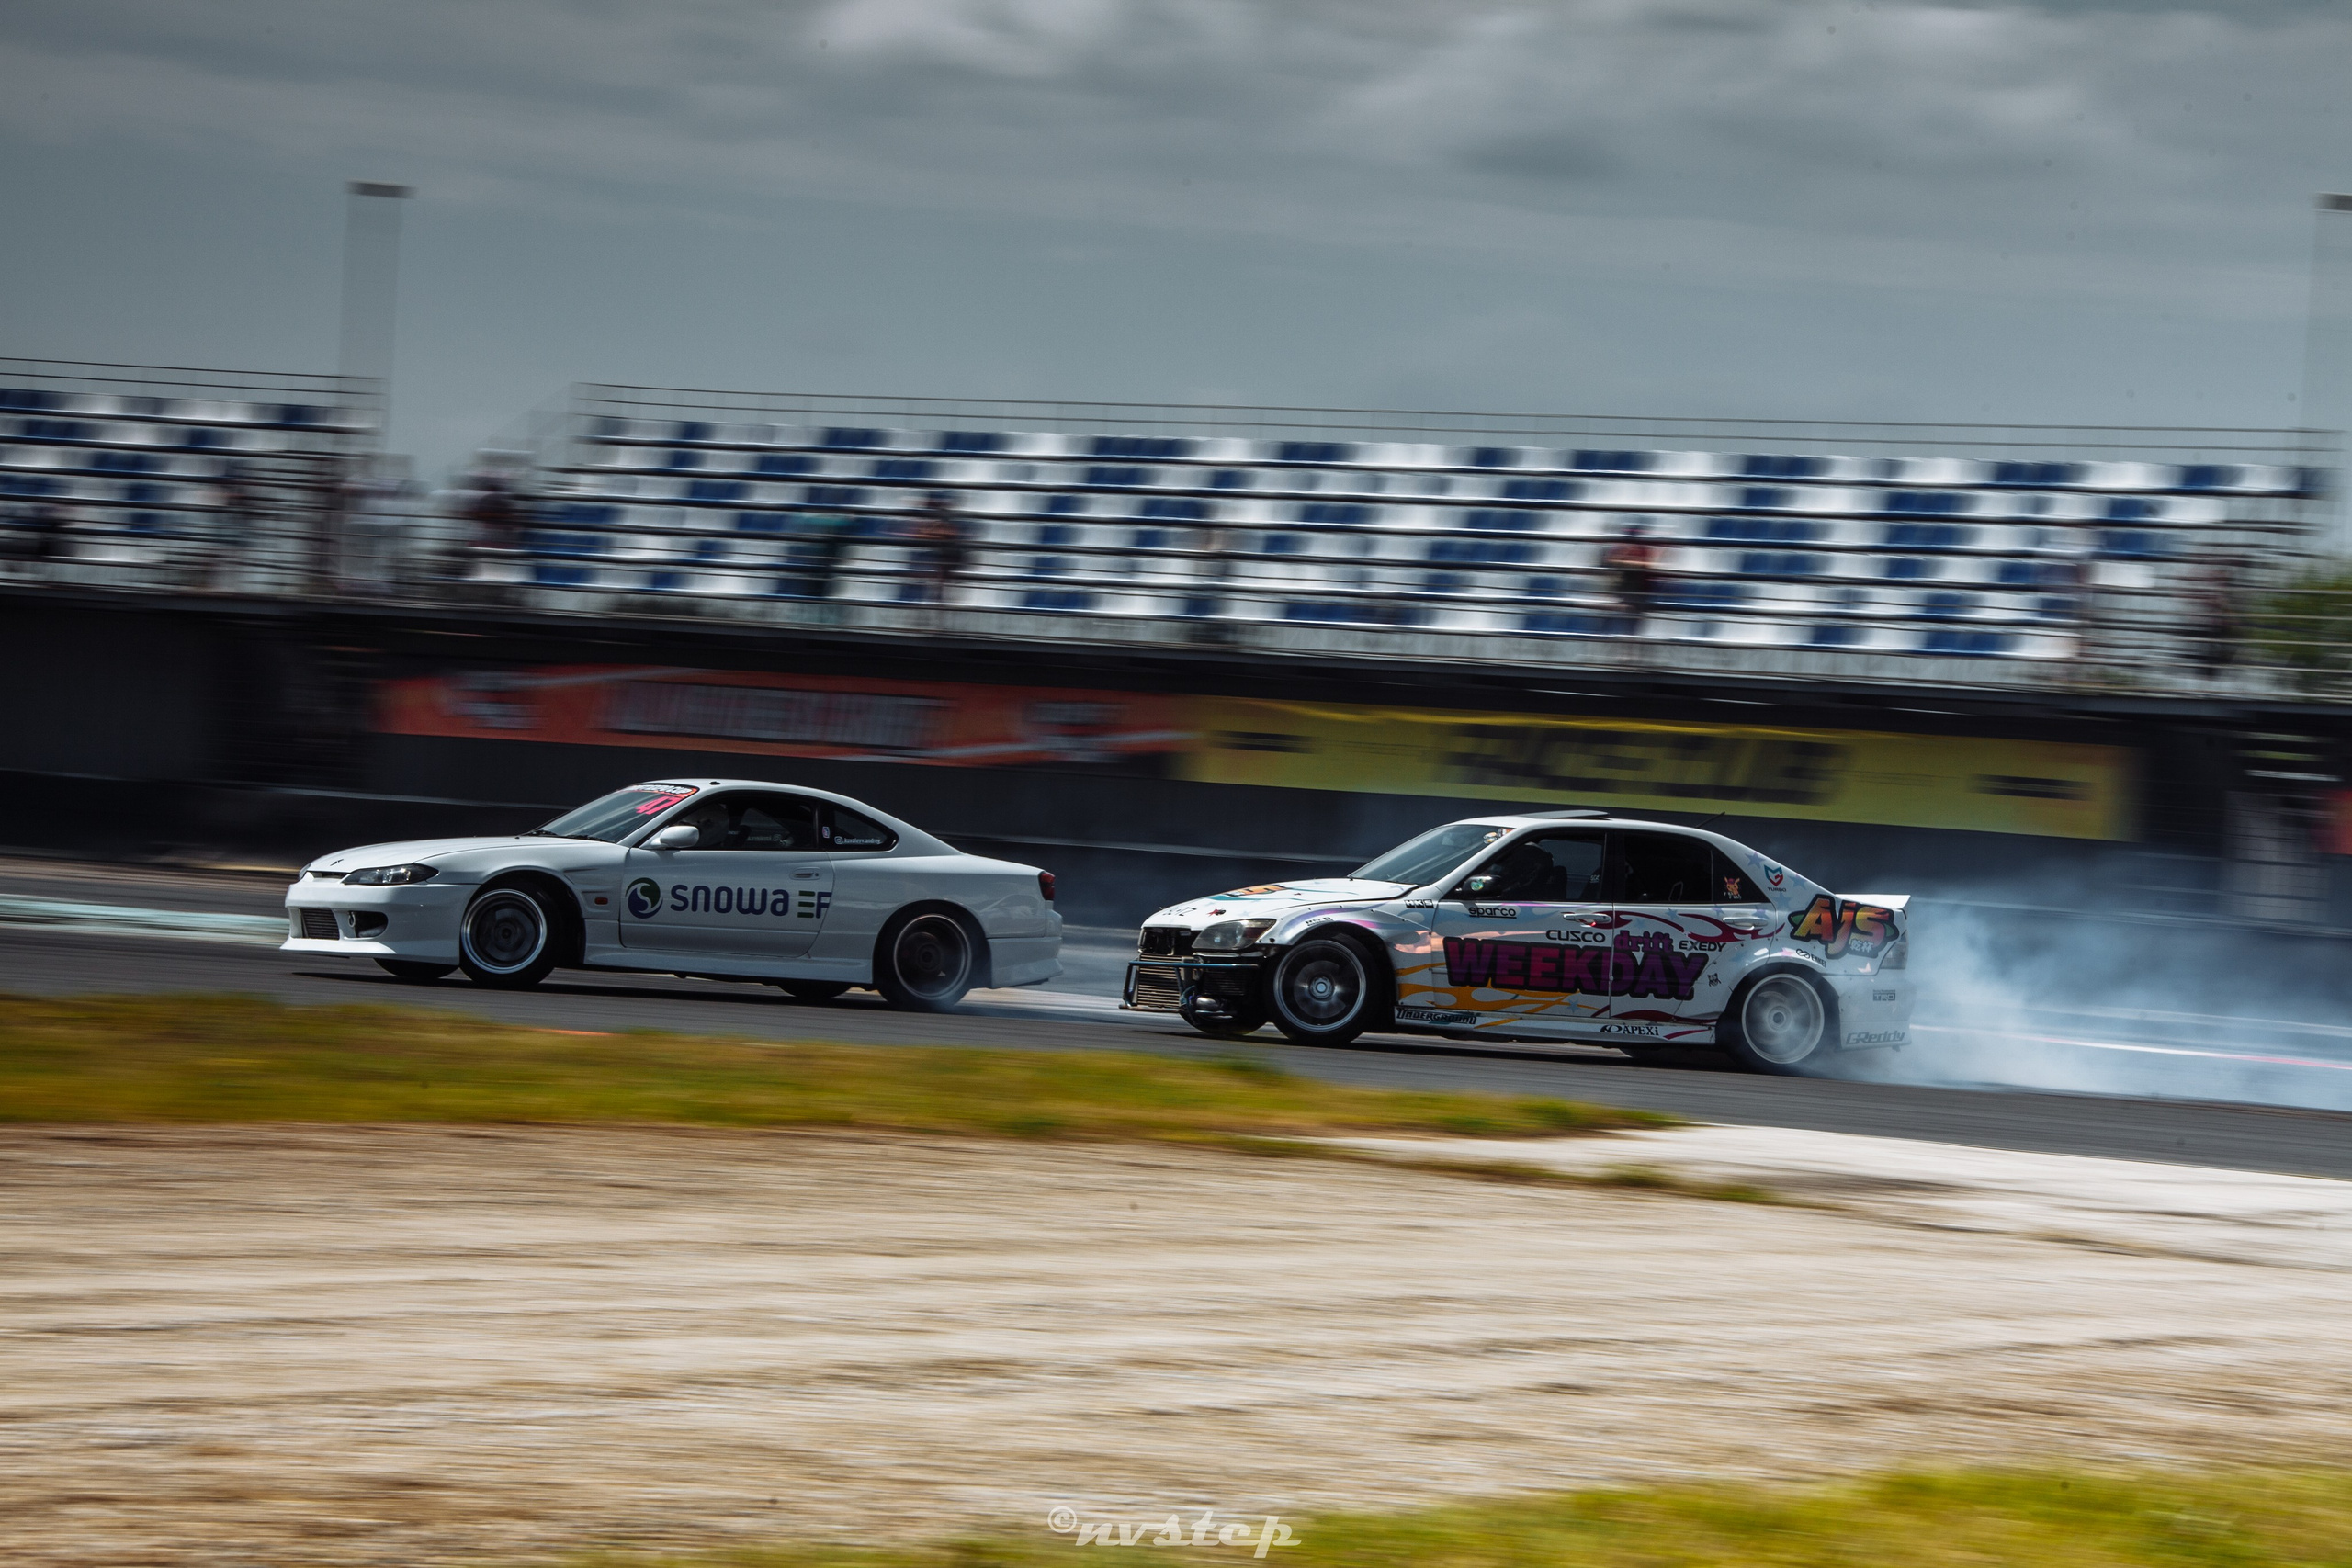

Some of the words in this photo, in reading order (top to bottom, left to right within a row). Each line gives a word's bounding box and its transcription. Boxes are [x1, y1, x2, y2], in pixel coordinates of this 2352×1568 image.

[635, 795, 682, 815] 47
[1404, 900, 1434, 908] HKS
[1469, 906, 1517, 917] sparco
[1545, 930, 1606, 942] CUSCO
[1614, 931, 1674, 952] drift
[1679, 941, 1726, 952] EXEDY
[1810, 953, 1826, 967] ENKEI
[1444, 938, 1707, 999] WEEKDAY
[1873, 993, 1895, 1001] TRD
[1846, 1031, 1905, 1044] GReddy
